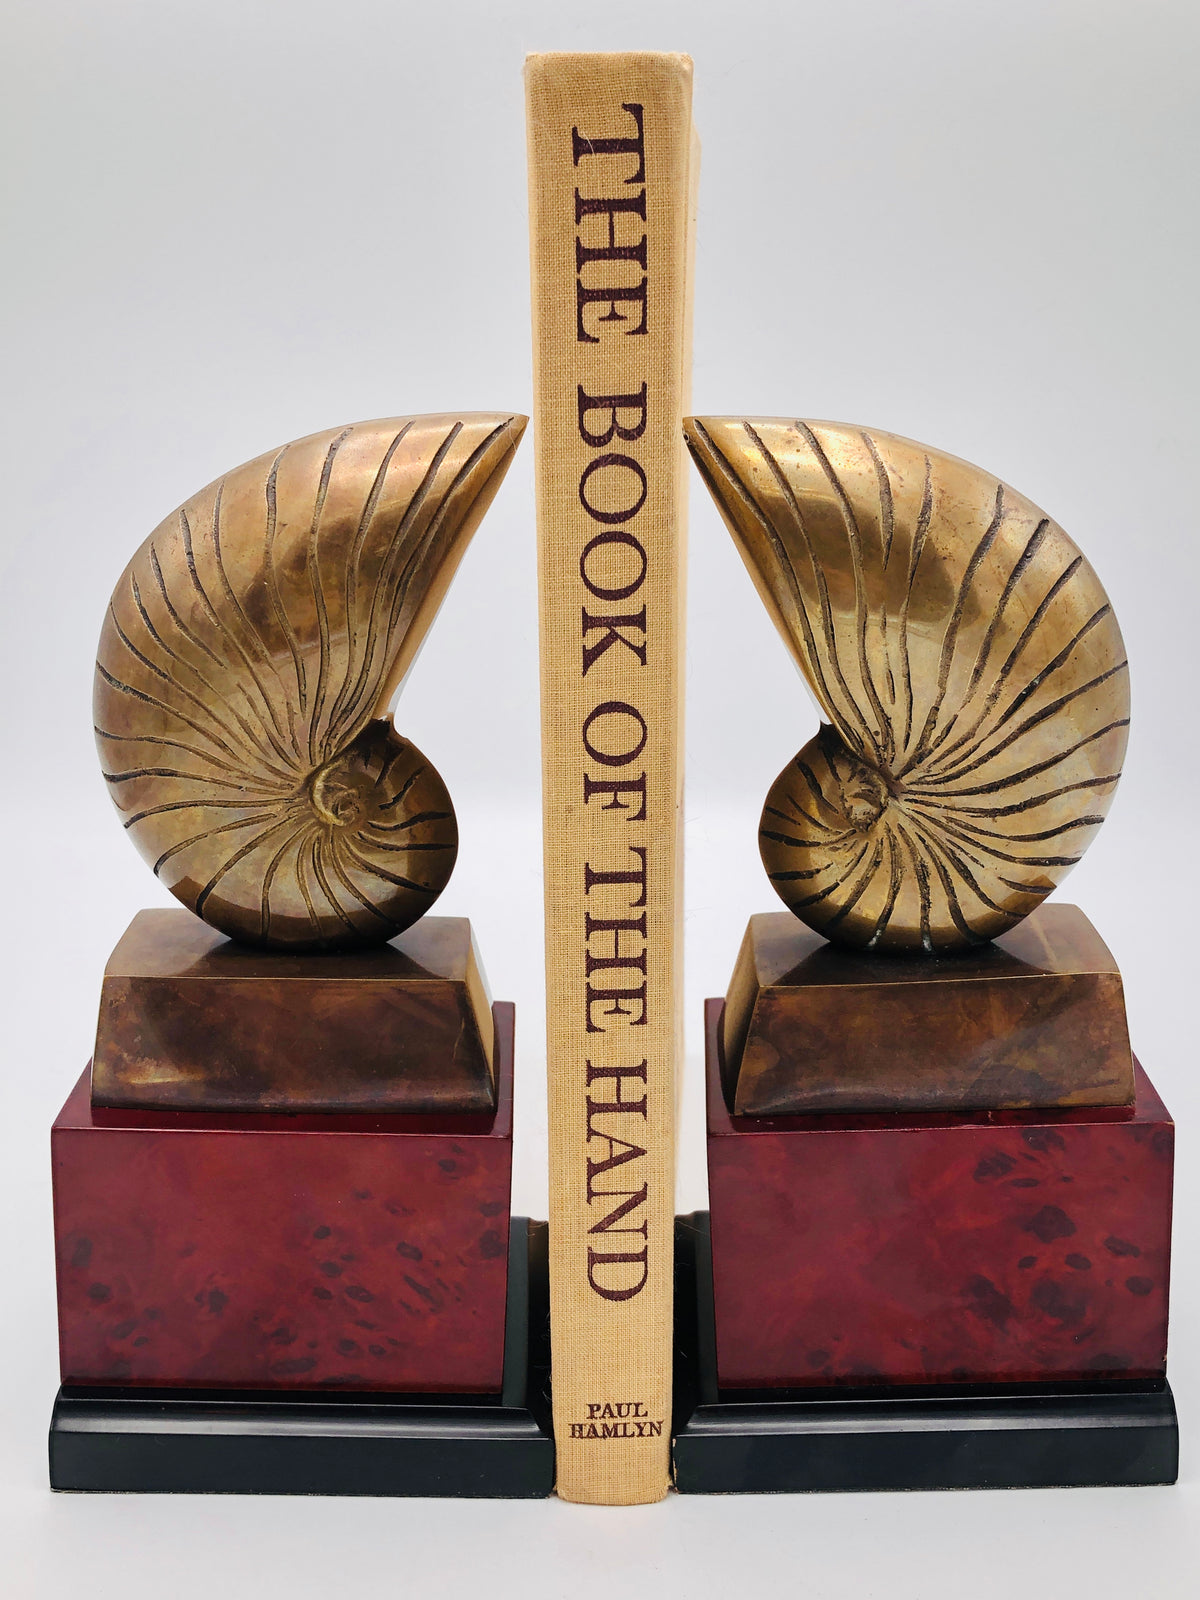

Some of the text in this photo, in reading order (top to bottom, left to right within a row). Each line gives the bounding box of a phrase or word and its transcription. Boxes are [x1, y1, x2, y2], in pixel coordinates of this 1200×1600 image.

[571, 102, 649, 1302] THE BOOK OF THE HAND
[586, 1402, 649, 1420] PAUL
[568, 1420, 664, 1440] HAMLYN
